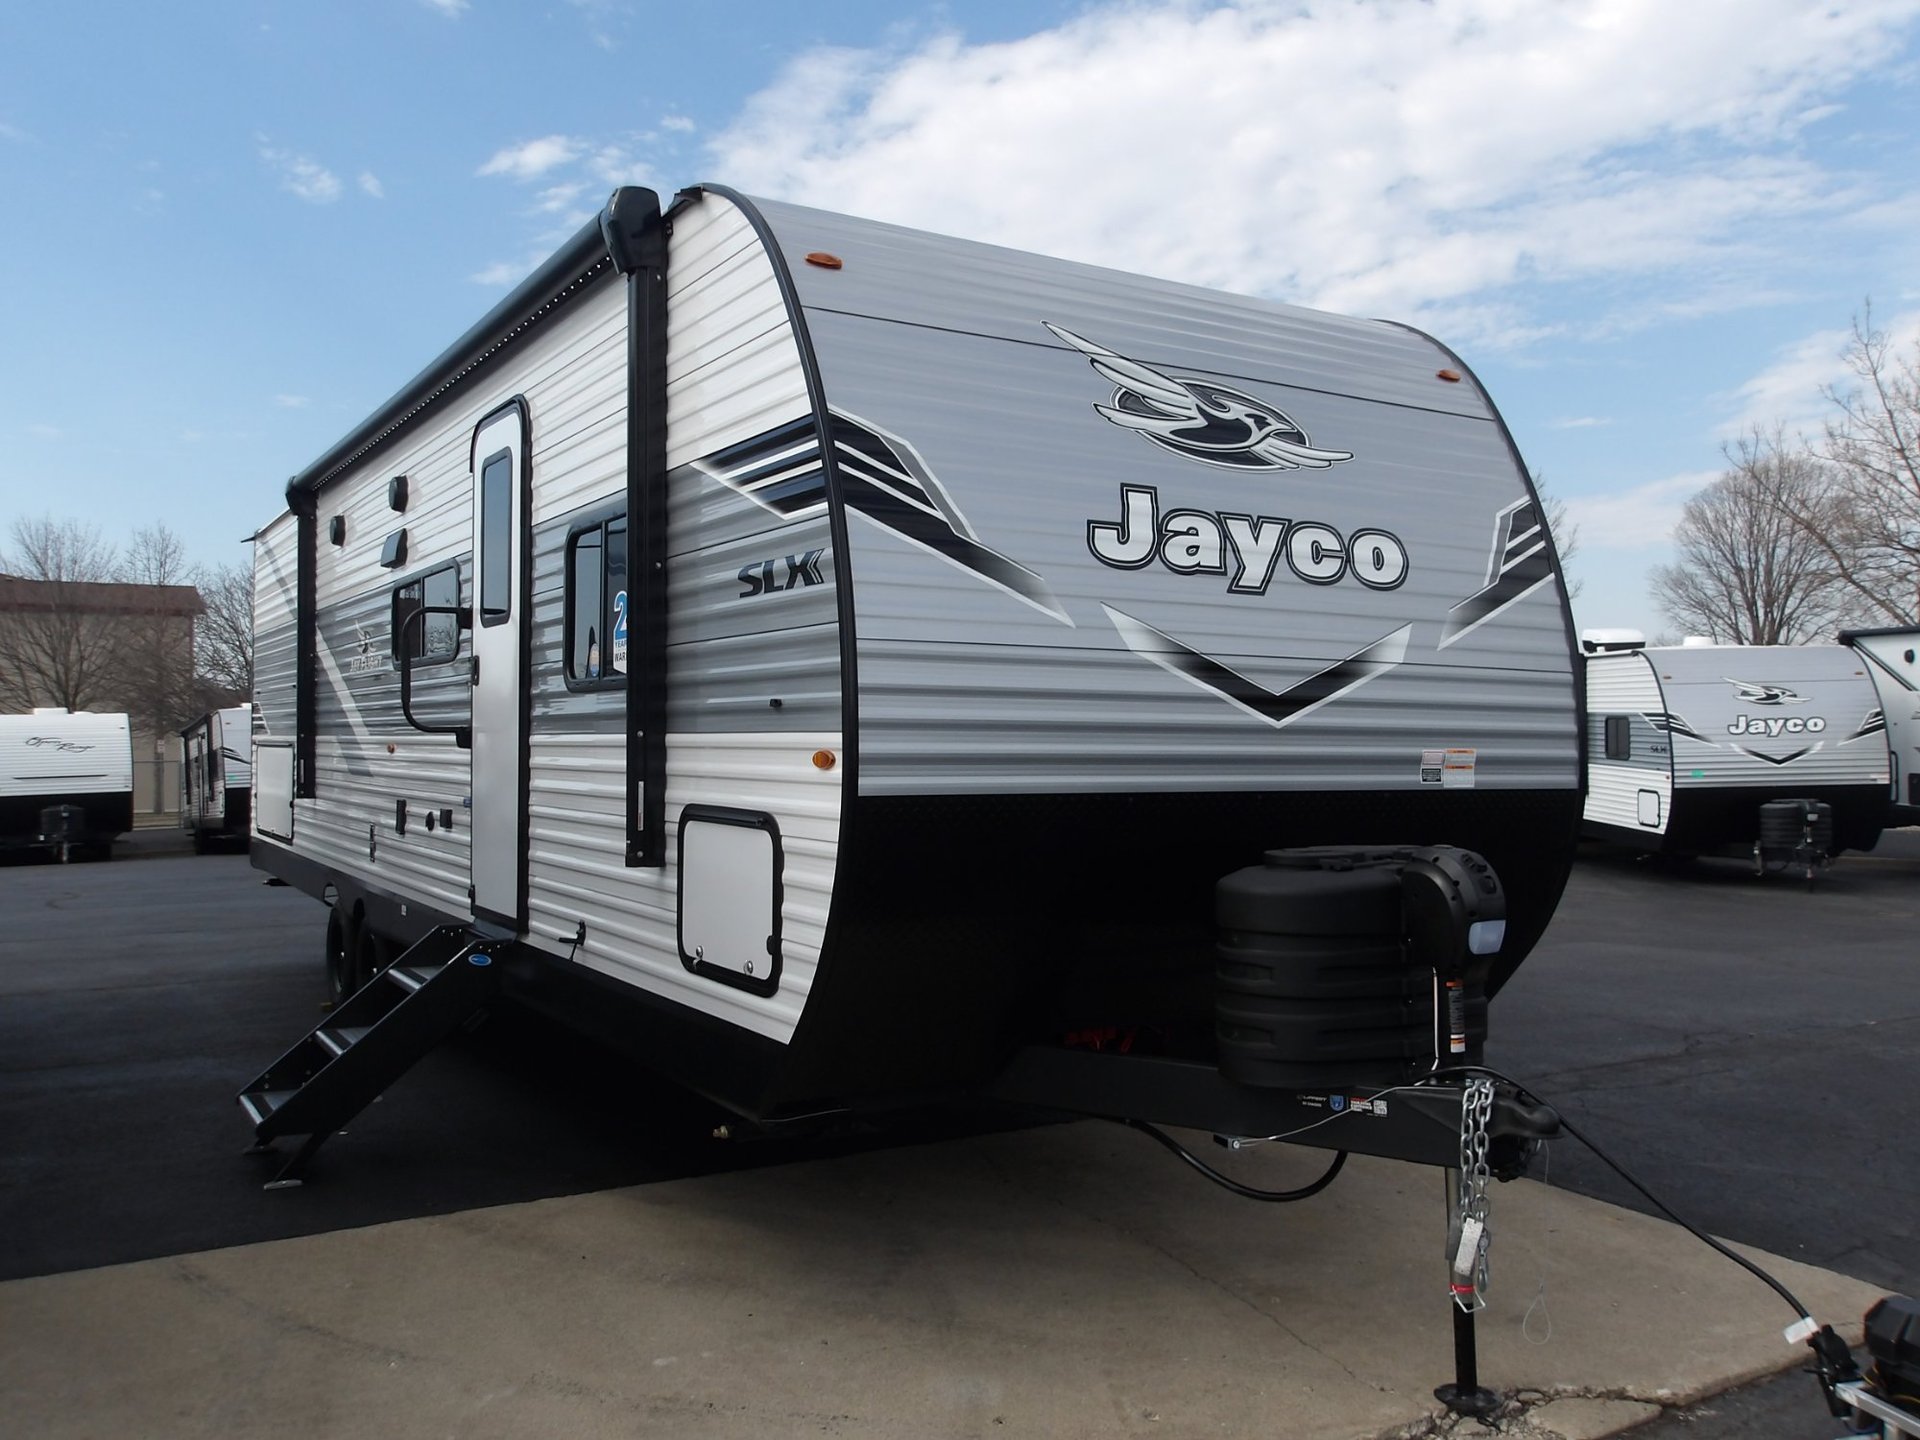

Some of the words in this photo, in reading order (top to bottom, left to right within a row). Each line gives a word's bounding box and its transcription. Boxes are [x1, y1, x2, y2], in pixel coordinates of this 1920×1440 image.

[1087, 483, 1409, 596] Jayco
[614, 591, 627, 640] 2
[1727, 714, 1826, 737] Jayco
